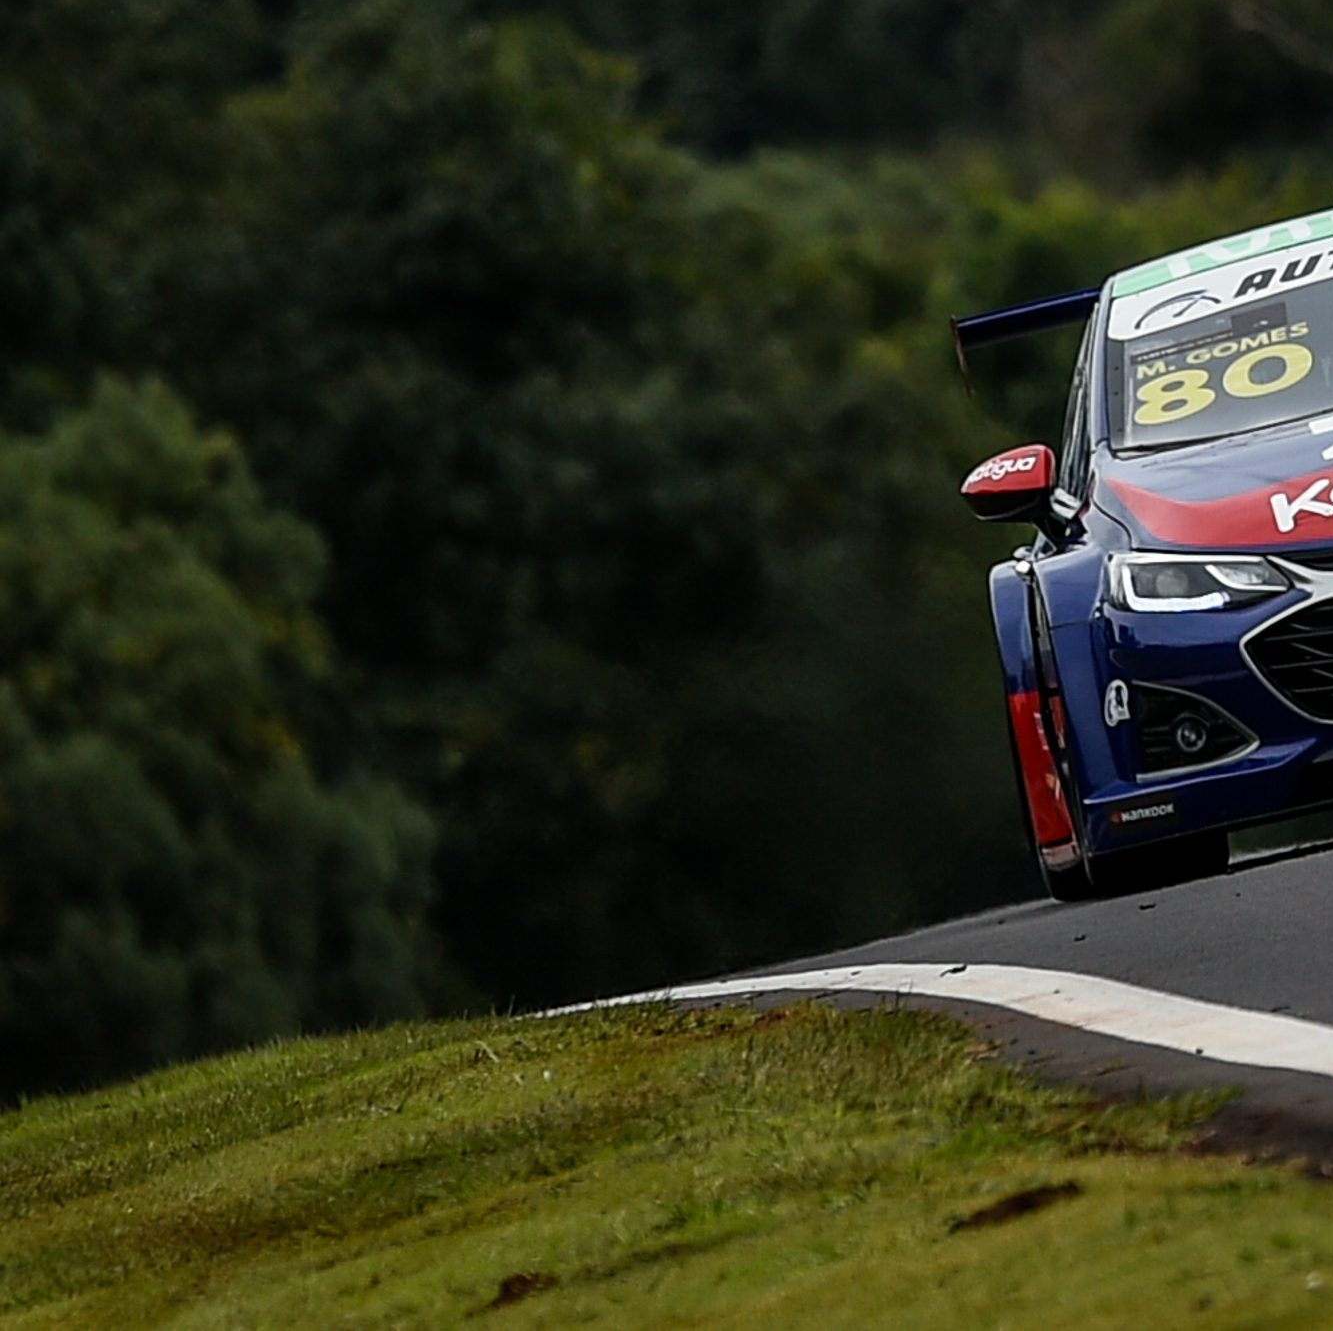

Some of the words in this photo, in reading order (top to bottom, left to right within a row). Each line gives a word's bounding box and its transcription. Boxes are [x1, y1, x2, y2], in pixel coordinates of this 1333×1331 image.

[1133, 342, 1313, 426] 80
[1136, 359, 1177, 380] M.
[1185, 321, 1310, 365] GOMES
